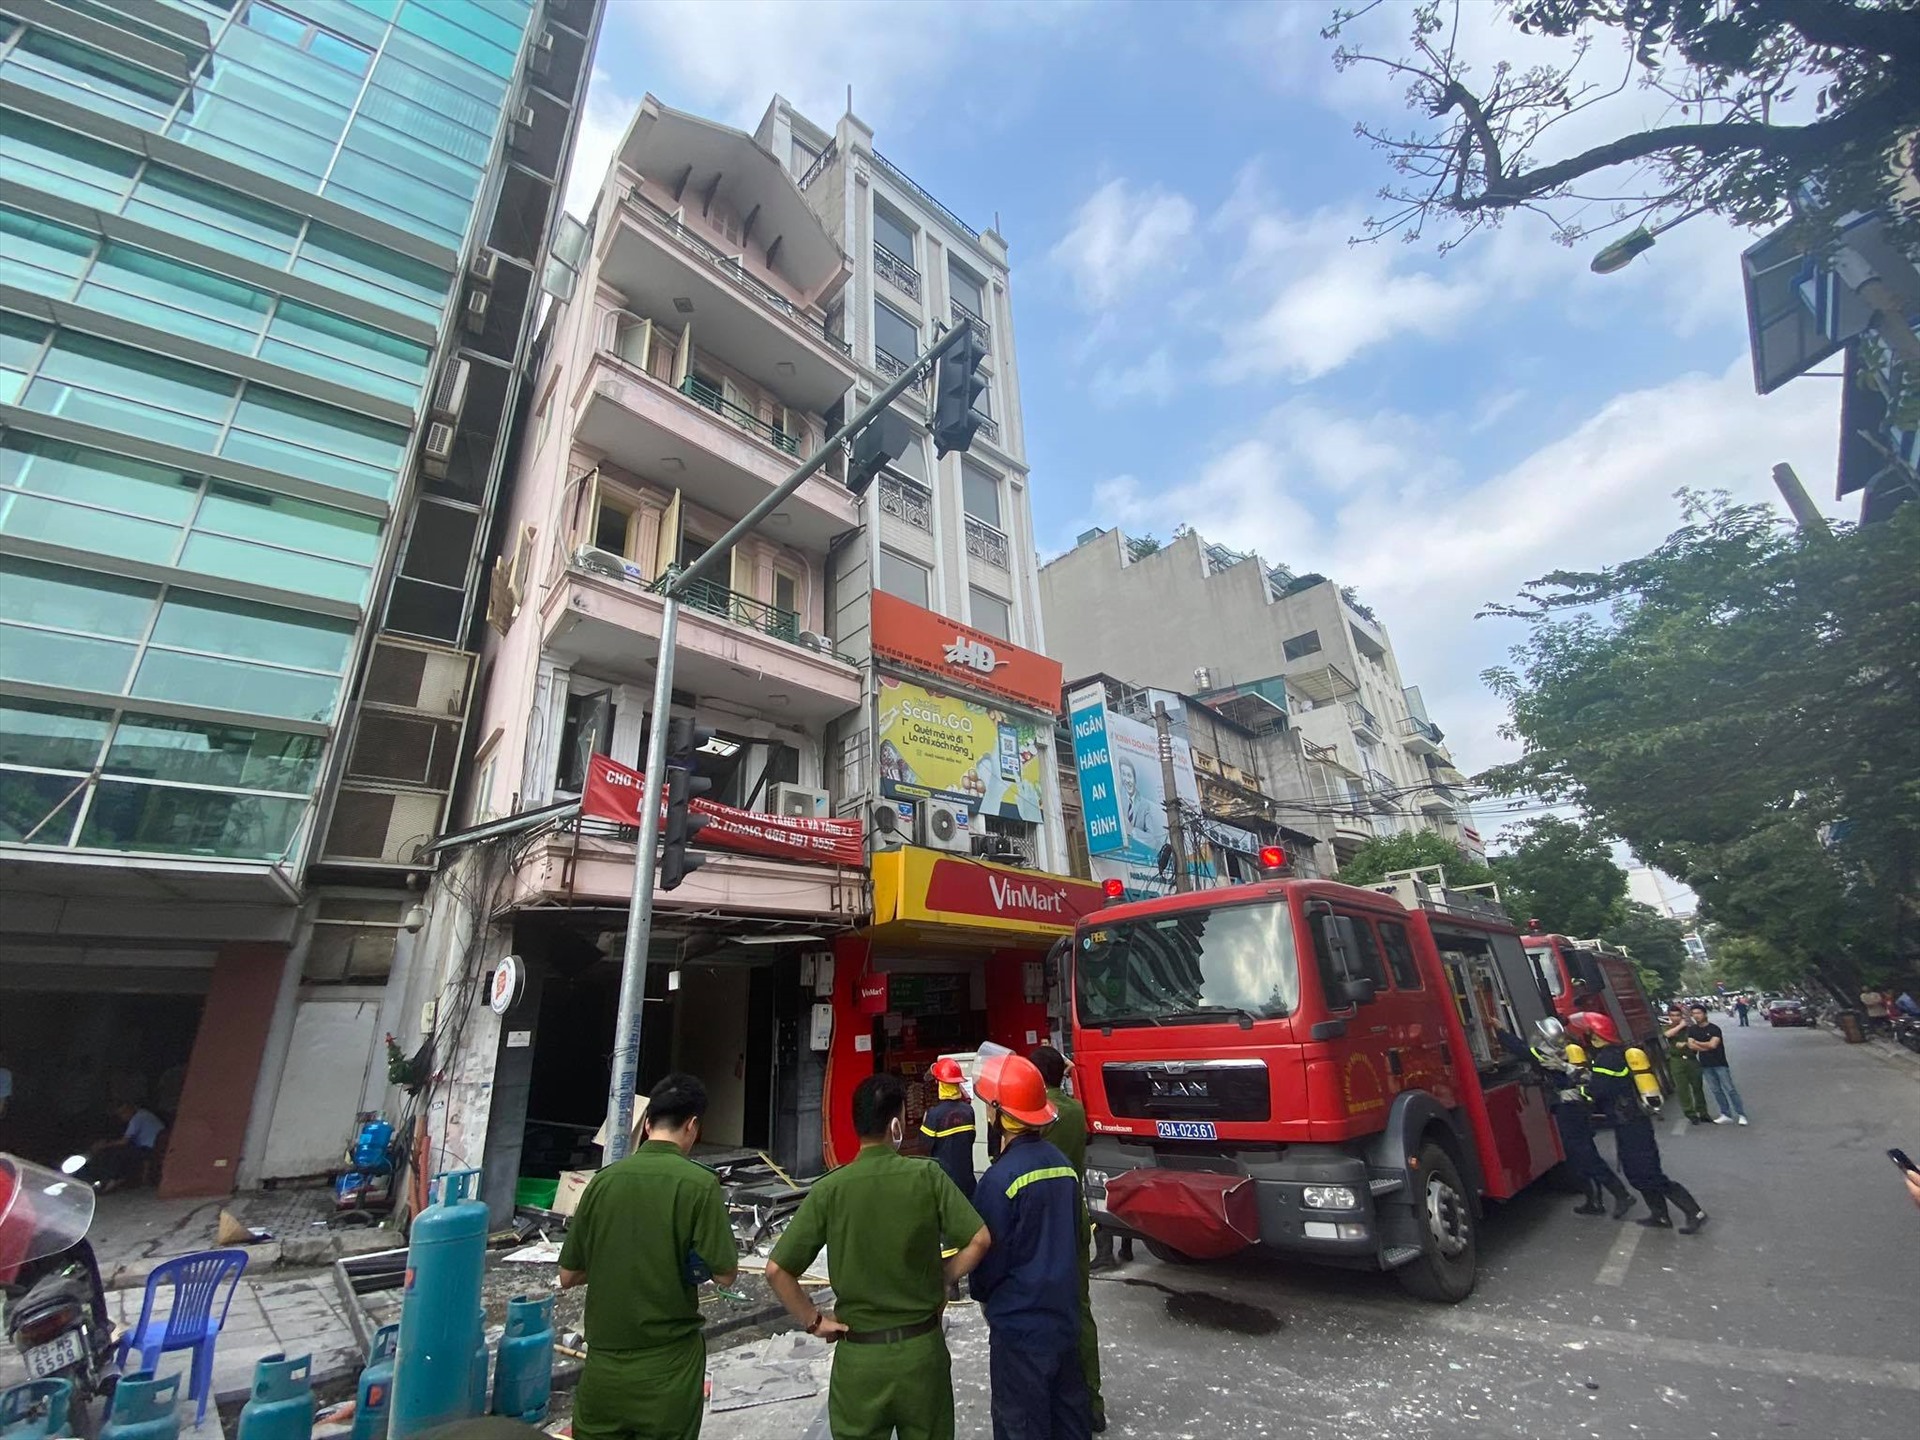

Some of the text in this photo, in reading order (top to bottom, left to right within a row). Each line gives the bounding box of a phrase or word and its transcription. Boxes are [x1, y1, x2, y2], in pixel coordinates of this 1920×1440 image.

[913, 723, 932, 736] Quét
[1075, 714, 1103, 739] NGÂN
[1080, 748, 1108, 771] HÀNG
[606, 769, 631, 786] CHO
[1092, 782, 1107, 802] AN
[1090, 814, 1117, 837] BÌNH
[36, 1349, 75, 1376] 6599
